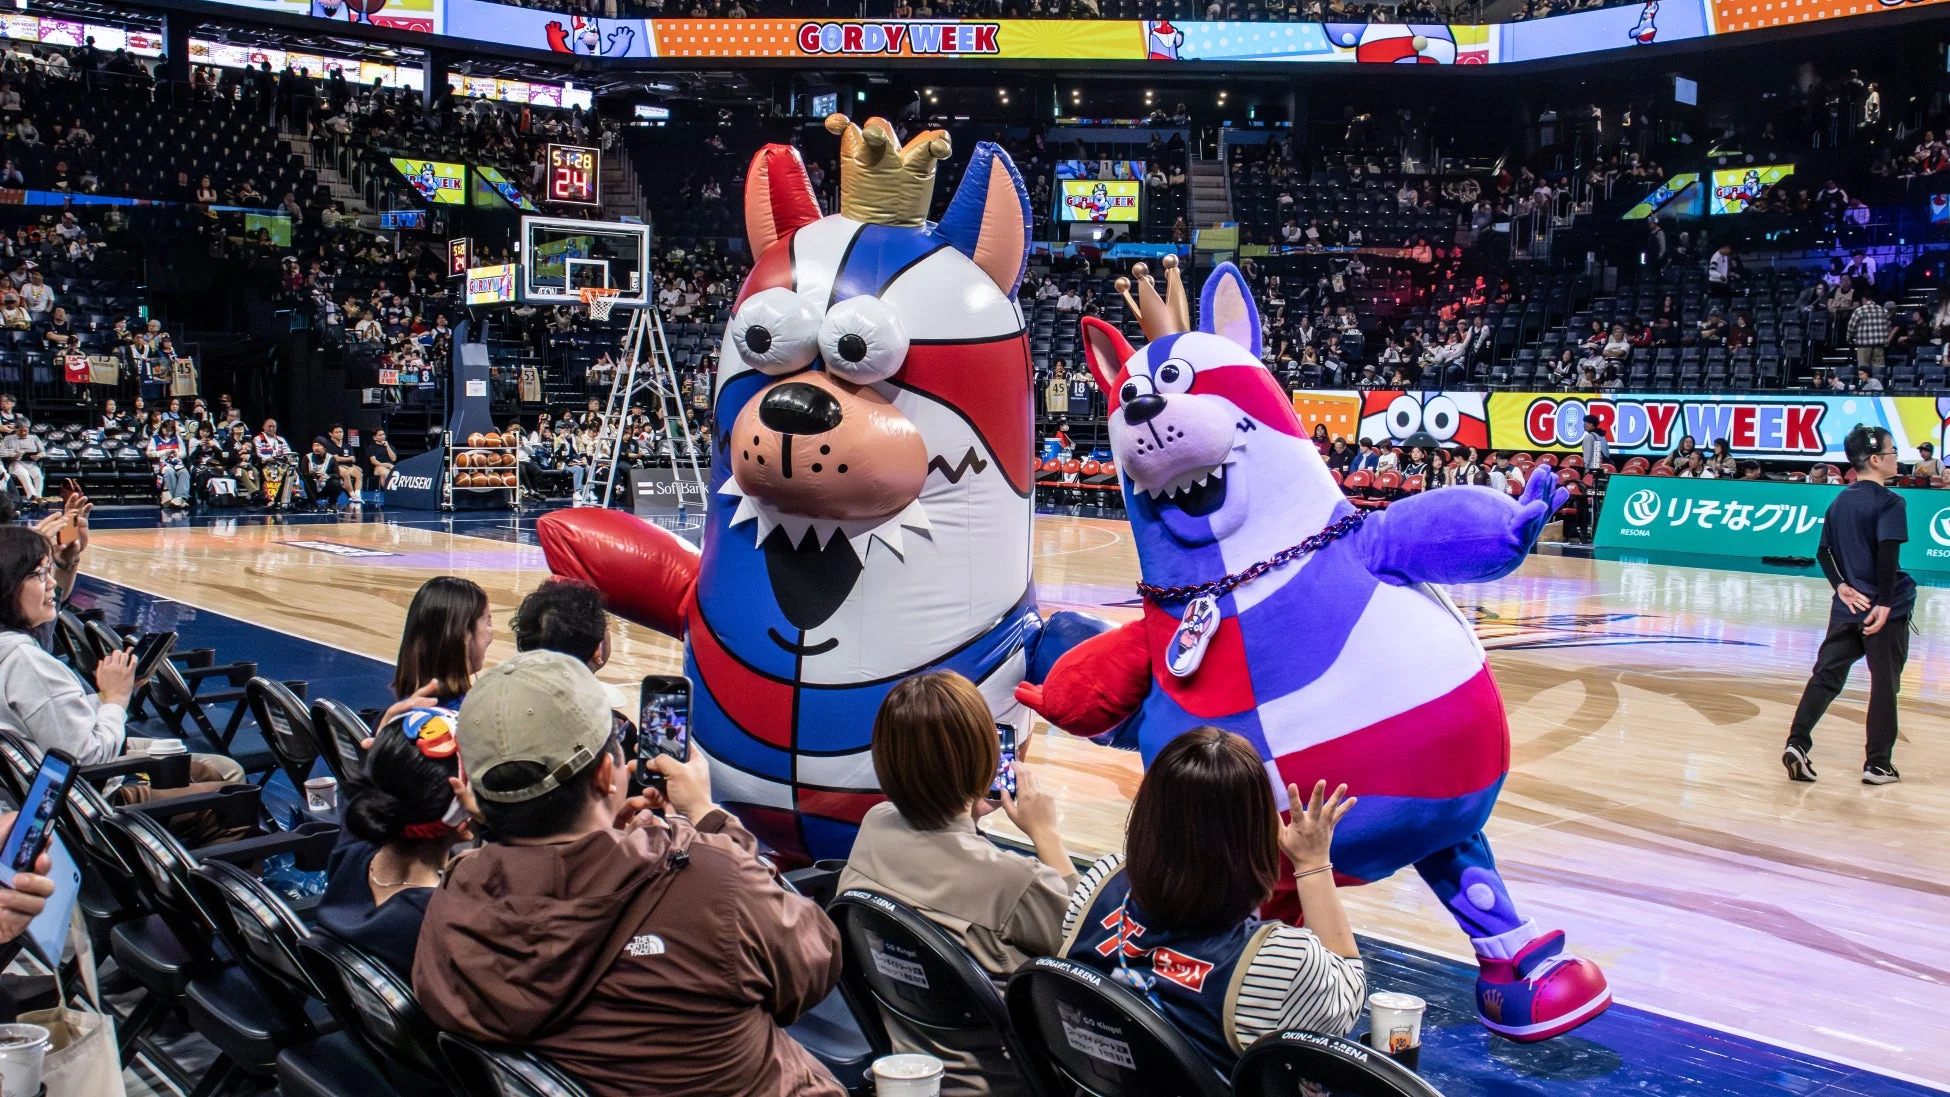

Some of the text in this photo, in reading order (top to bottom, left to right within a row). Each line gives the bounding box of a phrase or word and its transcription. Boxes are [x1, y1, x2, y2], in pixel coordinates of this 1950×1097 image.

[799, 23, 998, 53] GORDY WEEK
[552, 150, 592, 169] 51:28
[556, 168, 587, 197] 24
[1052, 383, 1065, 393] 45
[1074, 382, 1085, 393] 18
[1528, 400, 1824, 452] GORDY WEEK
[398, 475, 433, 490] RYUSEKI
[1667, 498, 1824, 534] りそなグル
[1620, 528, 1650, 537] RESONA
[1070, 967, 1101, 987] ARENA
[1329, 1041, 1369, 1063] ARENA
